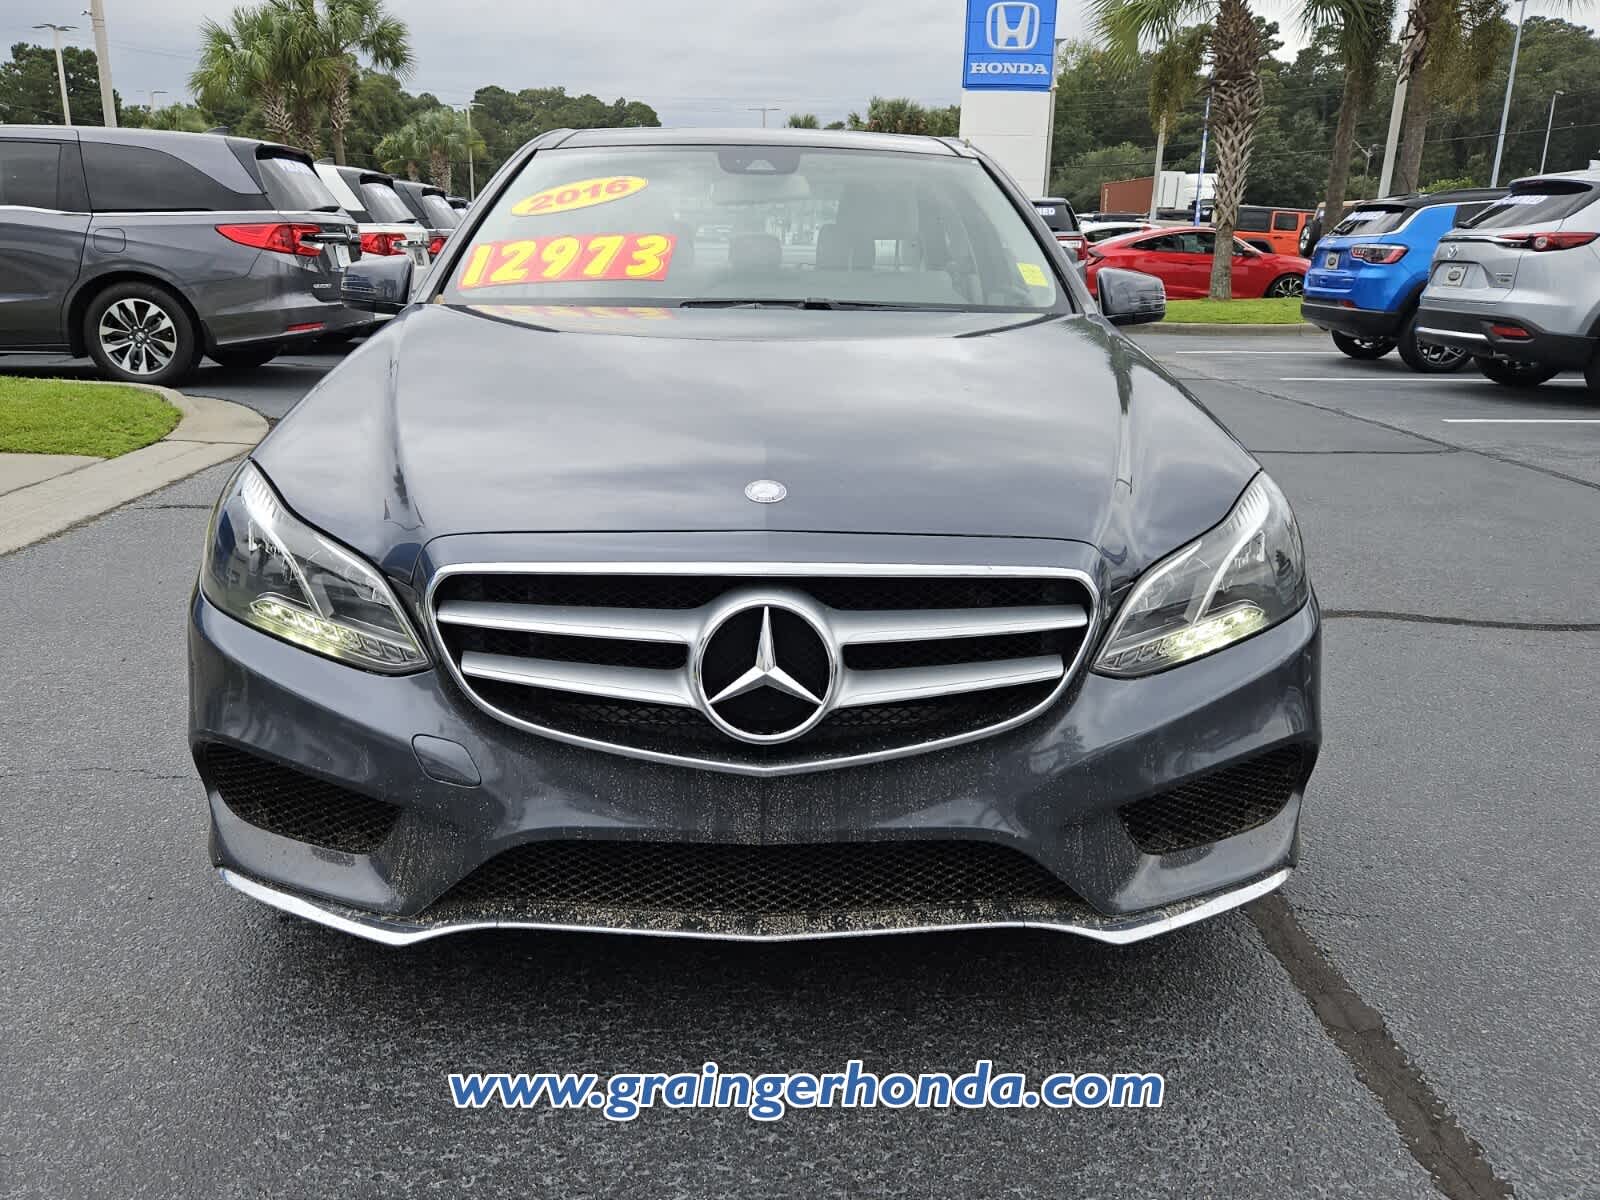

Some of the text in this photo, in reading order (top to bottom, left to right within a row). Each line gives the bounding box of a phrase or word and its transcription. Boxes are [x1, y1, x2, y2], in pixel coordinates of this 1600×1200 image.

[969, 62, 1049, 75] HONDA
[528, 179, 630, 213] 2016
[462, 235, 671, 288] 12973
